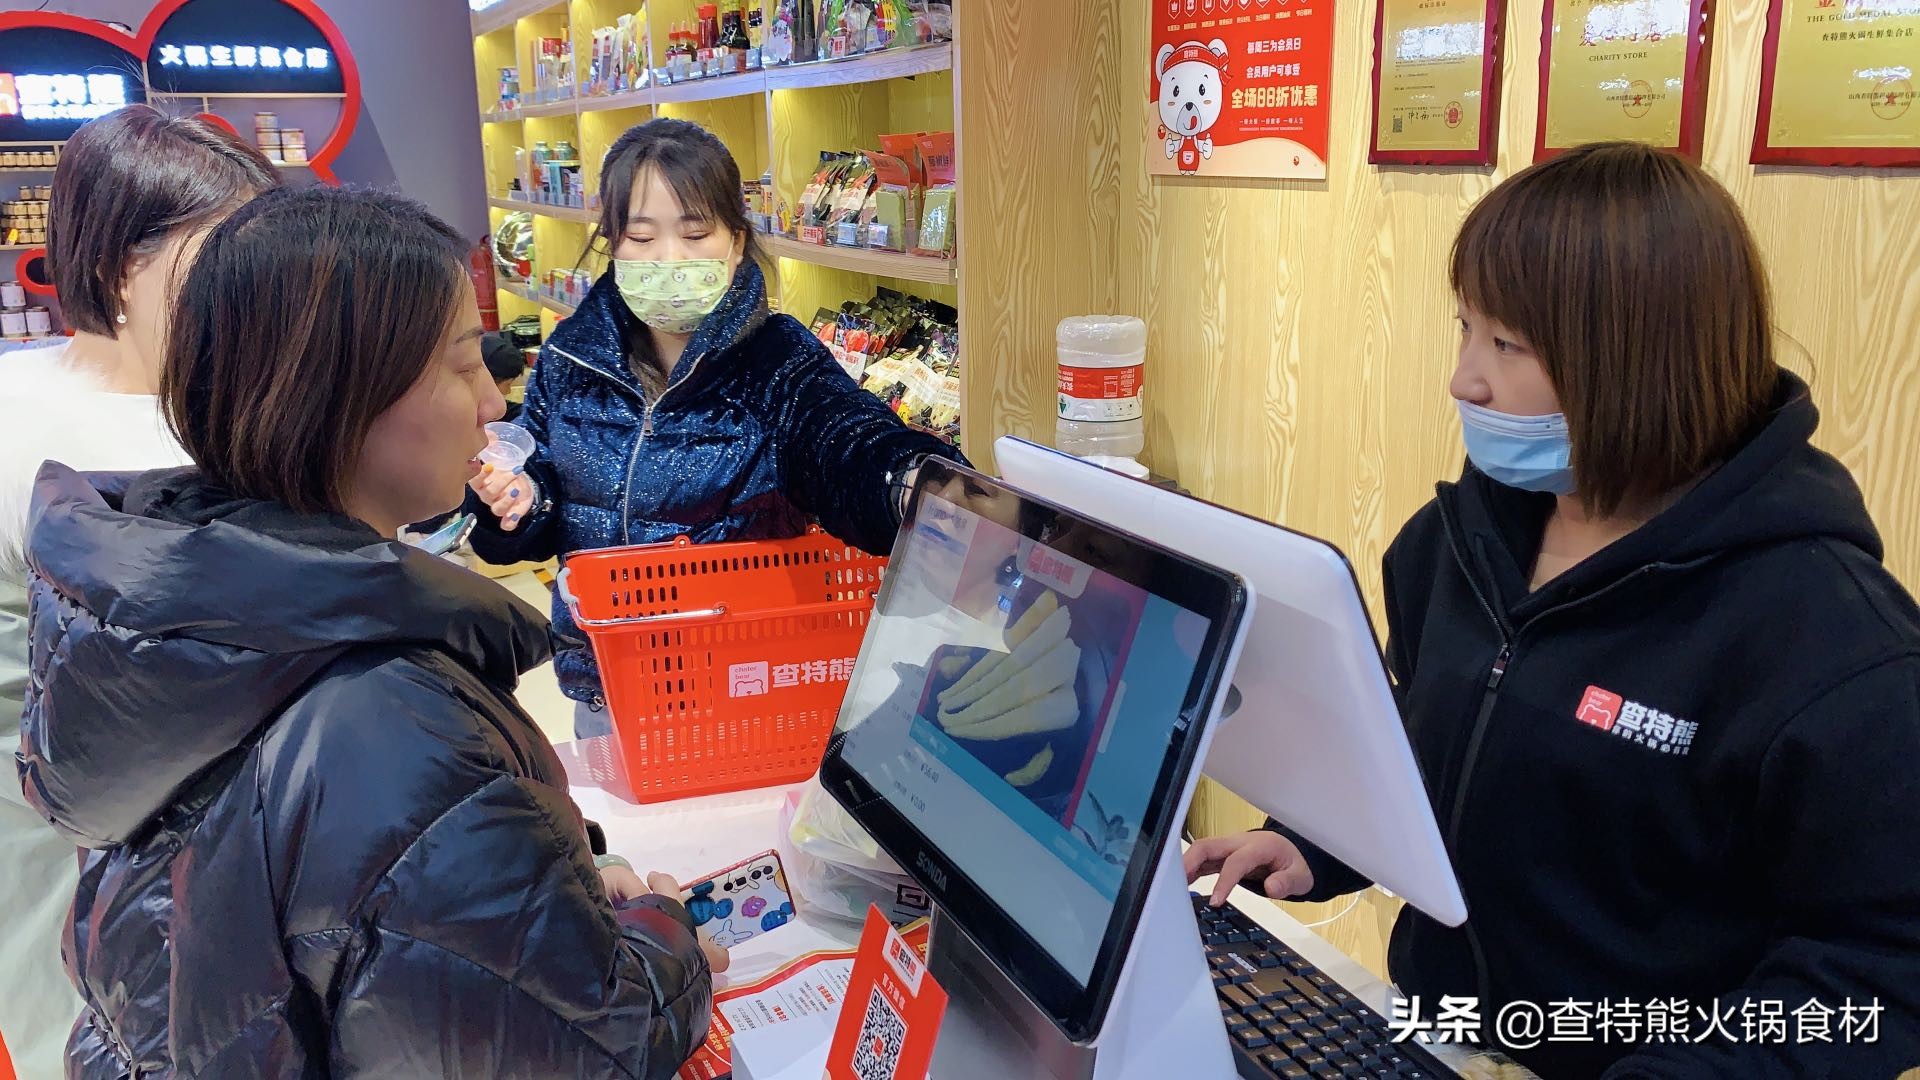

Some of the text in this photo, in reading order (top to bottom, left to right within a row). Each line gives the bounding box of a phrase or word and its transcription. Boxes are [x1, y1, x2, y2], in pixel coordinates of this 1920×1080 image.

[1807, 15, 1825, 23] THE
[1822, 28, 1914, 41] 查特熊火锅生鲜集合店
[1588, 51, 1648, 62] CHARITY STORE
[1246, 63, 1300, 79] 会员用户可享受
[1231, 84, 1318, 109] 全场88折优惠
[772, 657, 856, 688] 查特熊
[1616, 700, 1699, 745] 查特熊
[916, 850, 947, 892] SONDA
